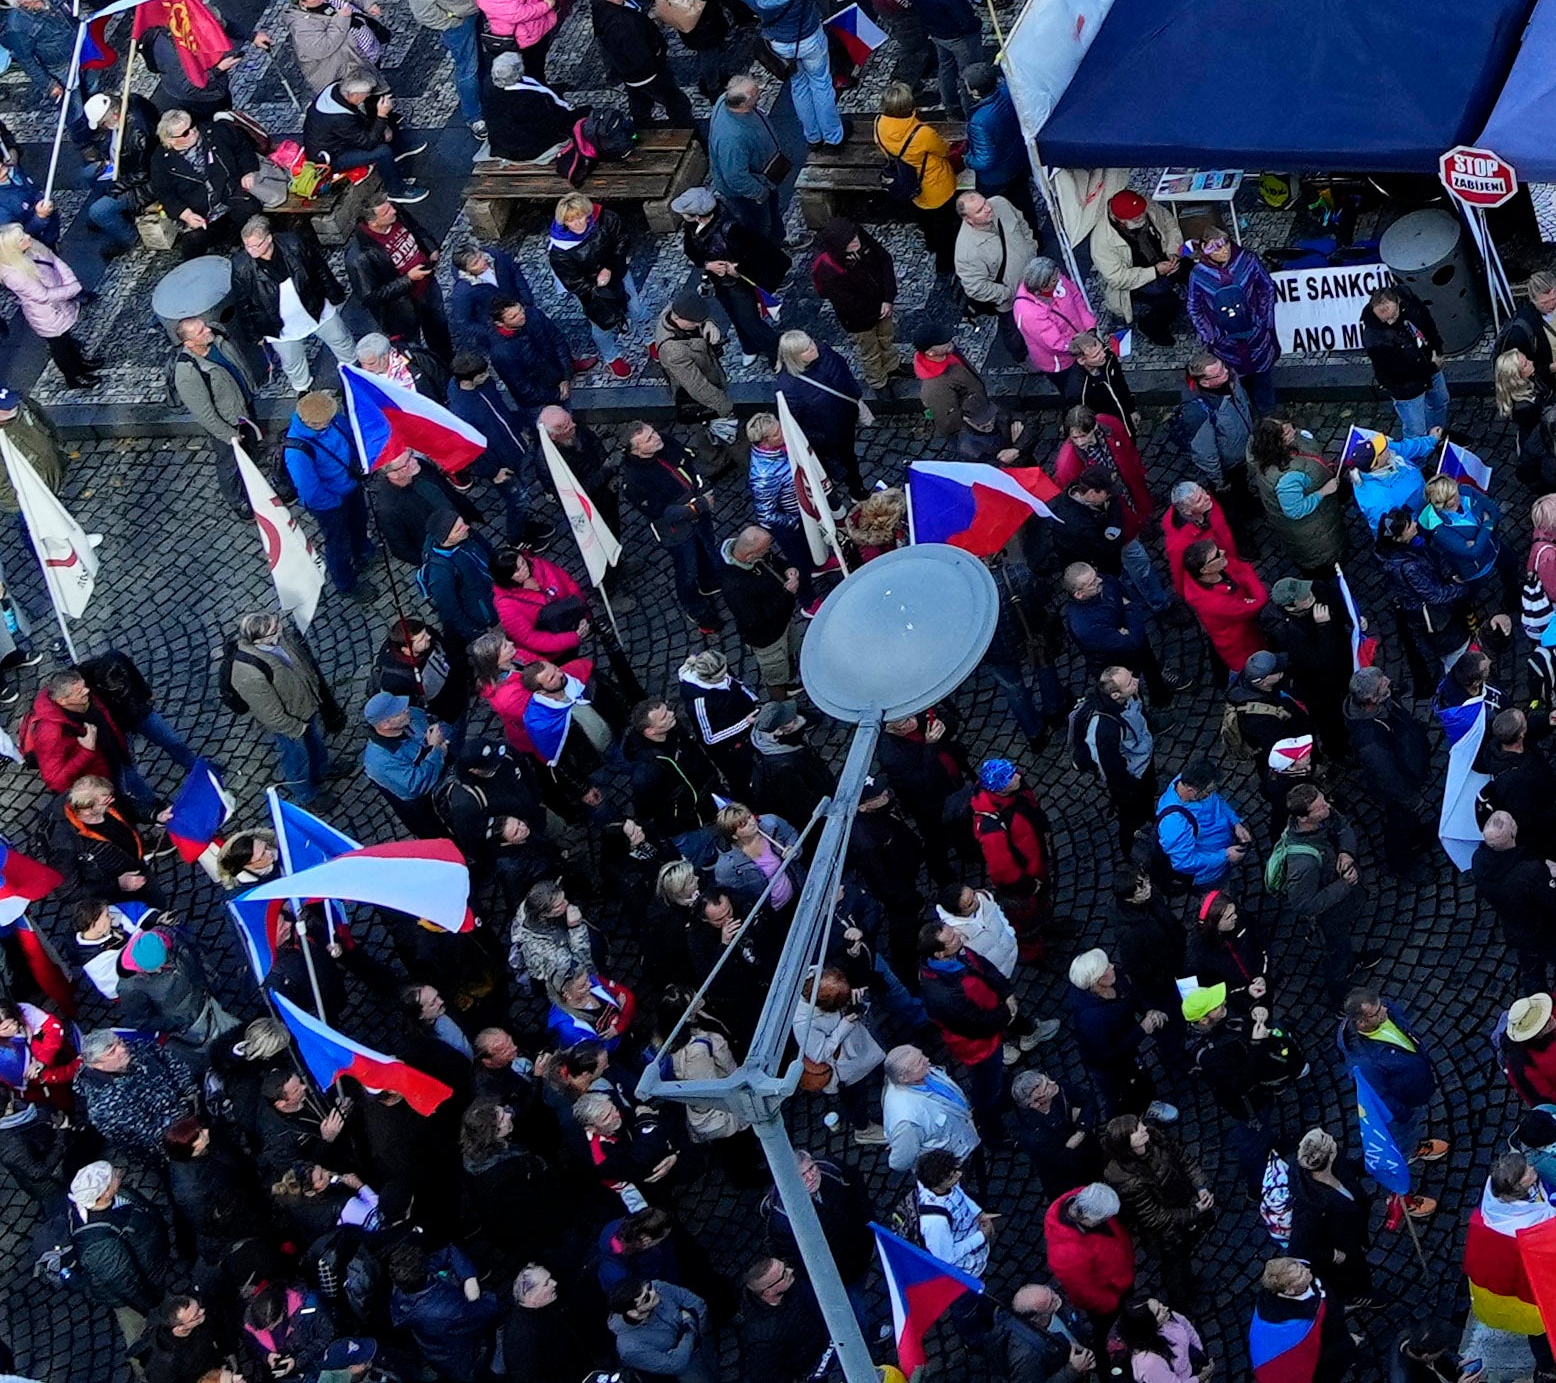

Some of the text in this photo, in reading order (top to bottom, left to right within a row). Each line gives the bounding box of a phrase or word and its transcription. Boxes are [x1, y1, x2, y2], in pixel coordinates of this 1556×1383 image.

[1454, 153, 1500, 177] STOP
[1274, 277, 1301, 304] NE
[1293, 324, 1336, 352] ANO
